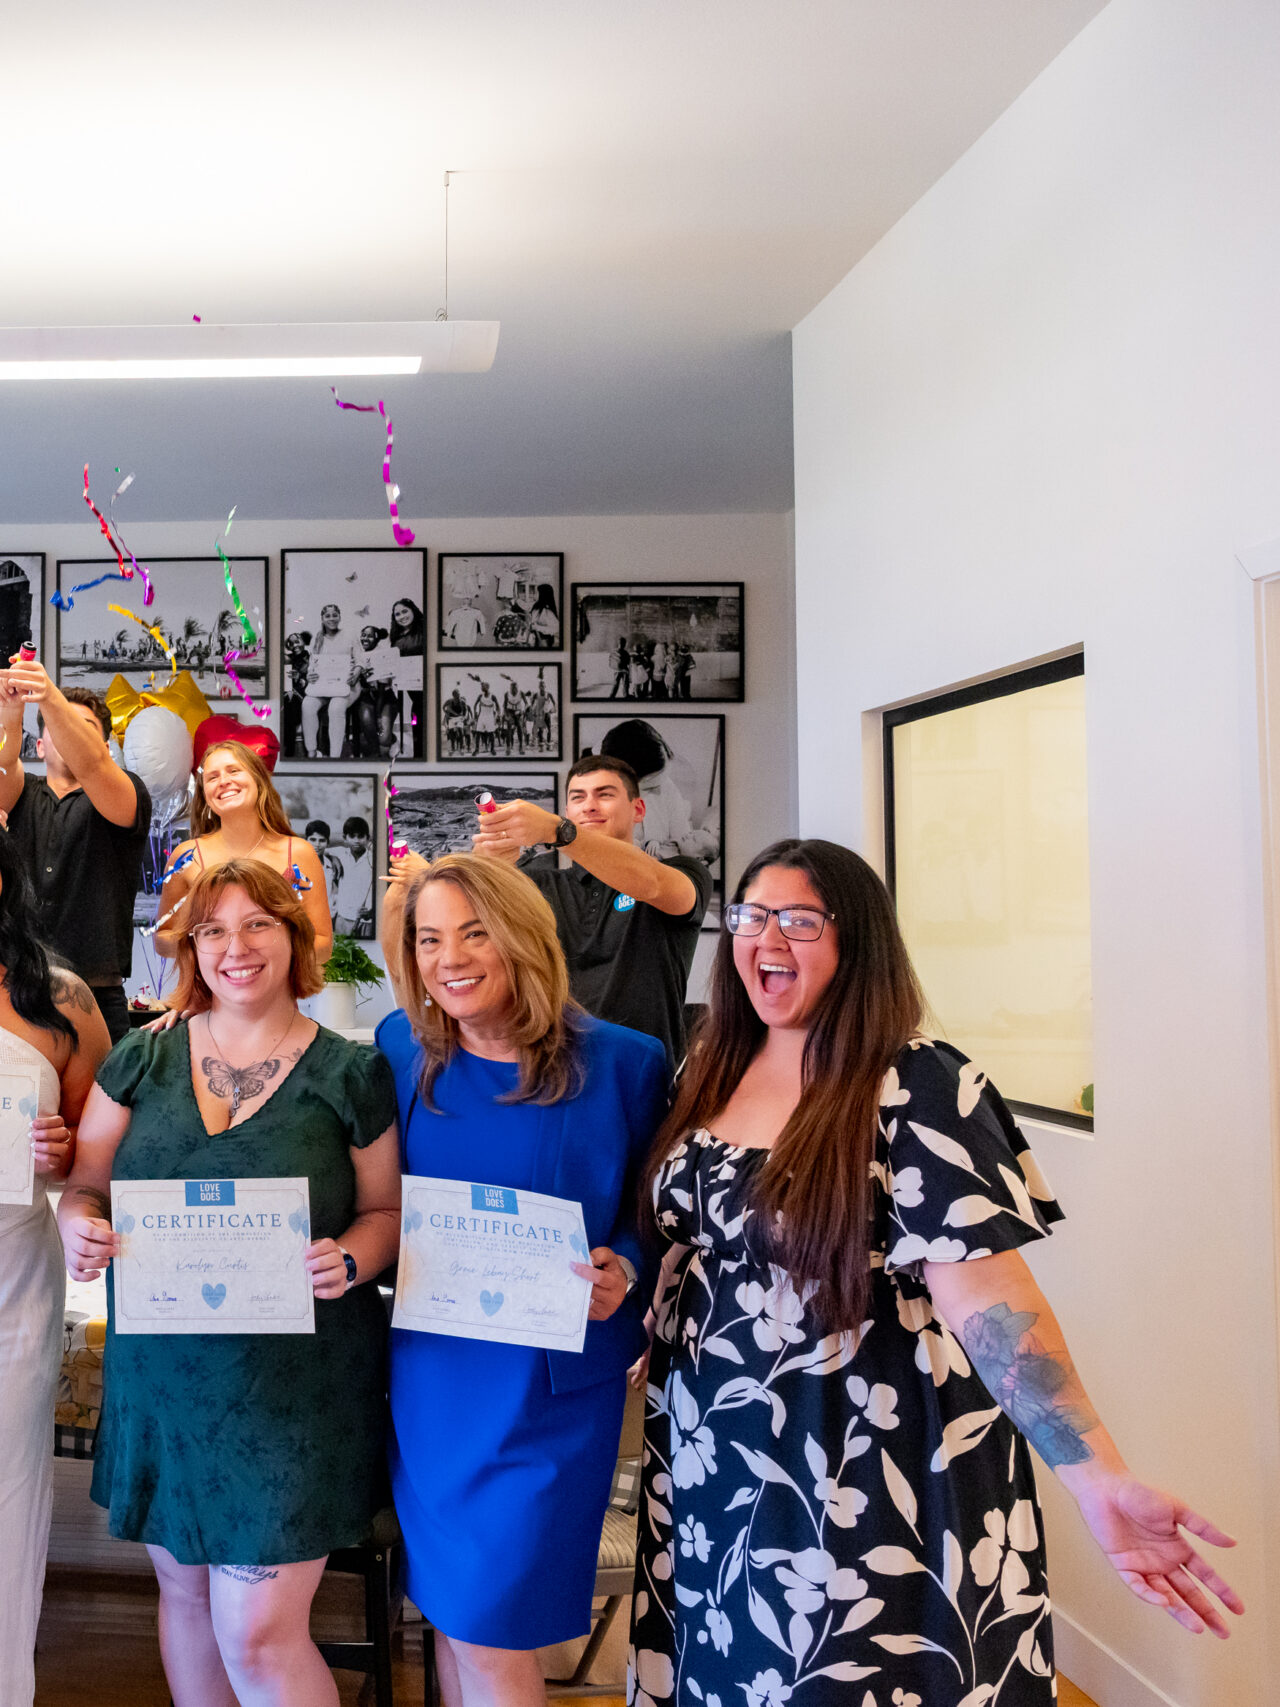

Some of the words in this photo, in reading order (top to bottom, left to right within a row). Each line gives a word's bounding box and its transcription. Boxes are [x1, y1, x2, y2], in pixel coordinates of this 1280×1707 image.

[618, 897, 635, 909] DOES
[199, 1183, 220, 1192] LOVE
[484, 1188, 504, 1198] LOVE
[200, 1192, 221, 1201] DOES
[485, 1198, 505, 1208] DOES
[142, 1213, 282, 1229] CERTIFICATE
[430, 1213, 564, 1244] CERTIFICATE
[231, 1564, 279, 1585] ways
